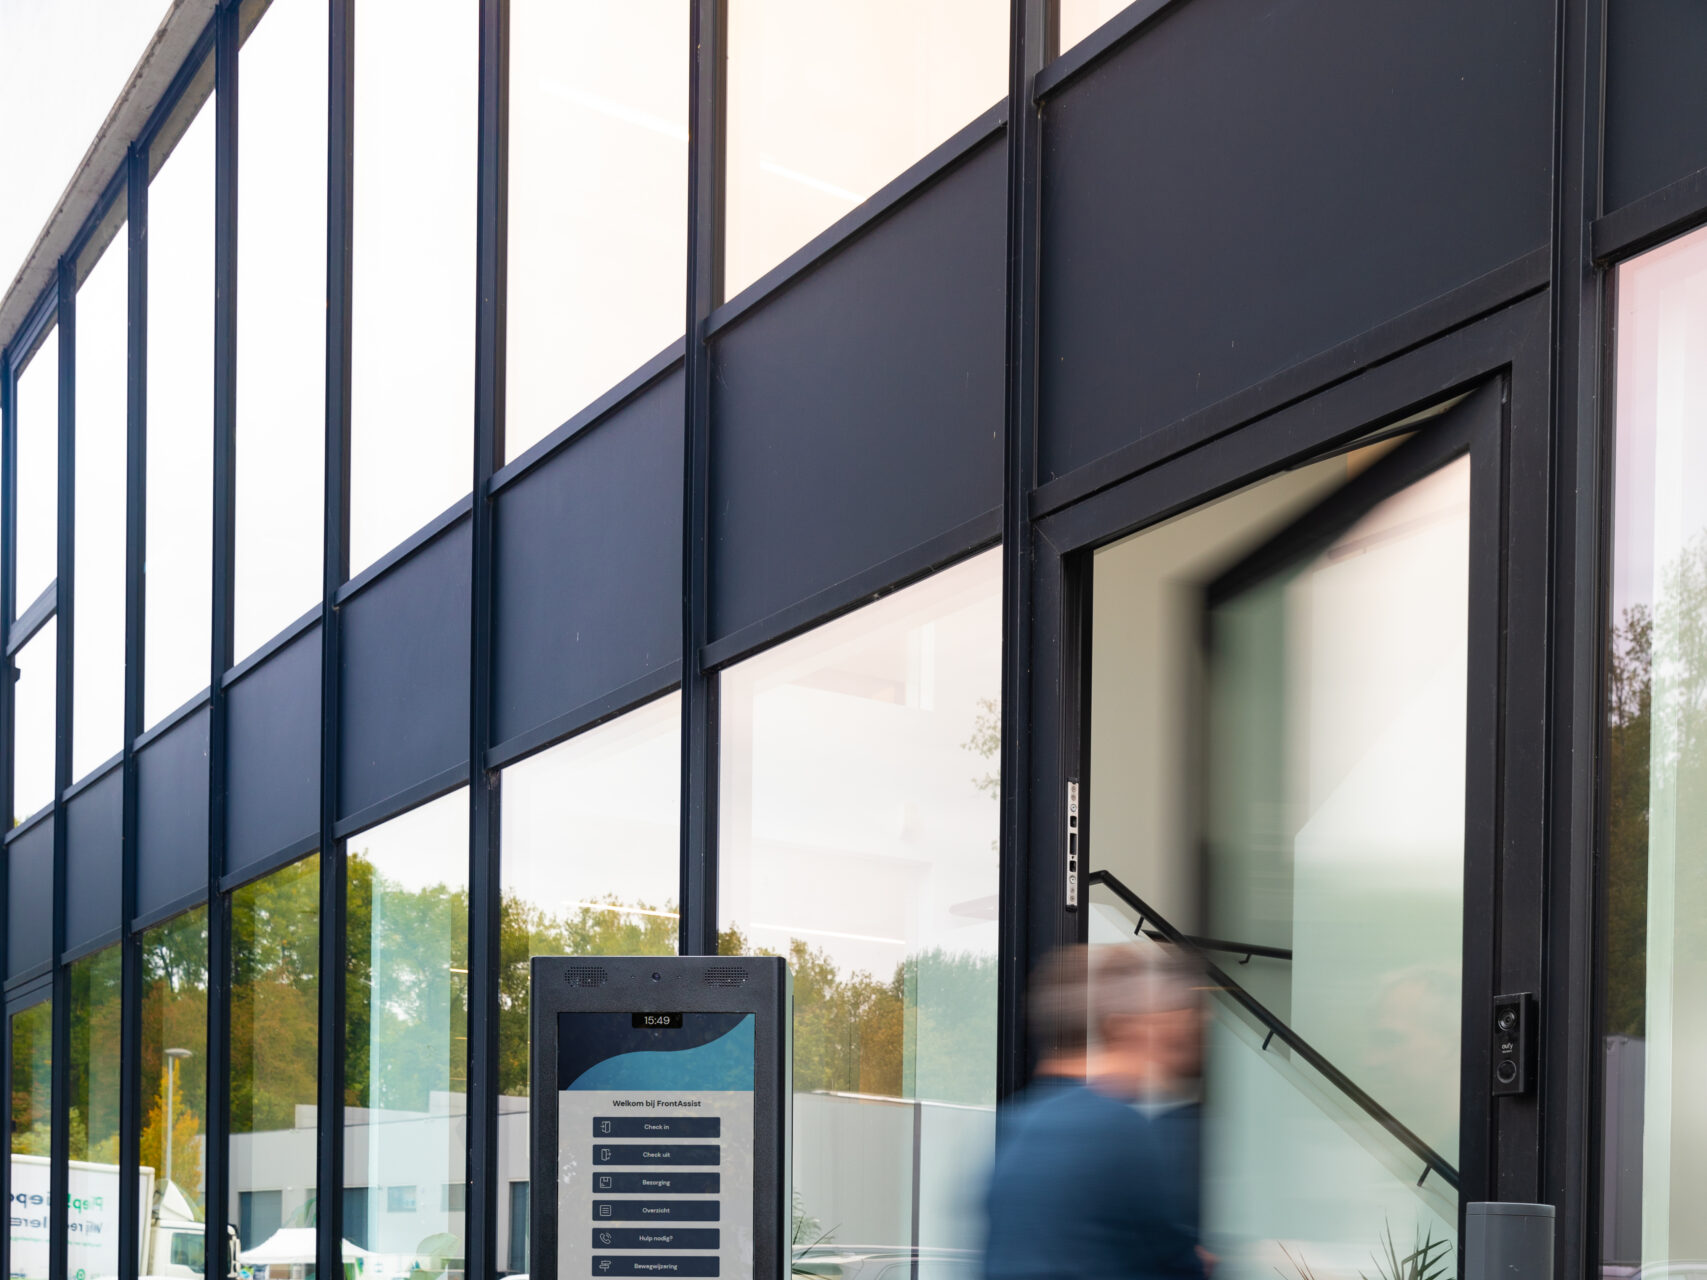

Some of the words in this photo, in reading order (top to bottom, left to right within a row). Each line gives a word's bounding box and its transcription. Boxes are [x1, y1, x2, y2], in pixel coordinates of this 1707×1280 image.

[644, 1016, 670, 1025] 15:49
[612, 1100, 644, 1108] Welkom
[645, 1100, 655, 1109] bij
[657, 1100, 701, 1108] FrontAssist
[653, 1235, 673, 1243] nodig?
